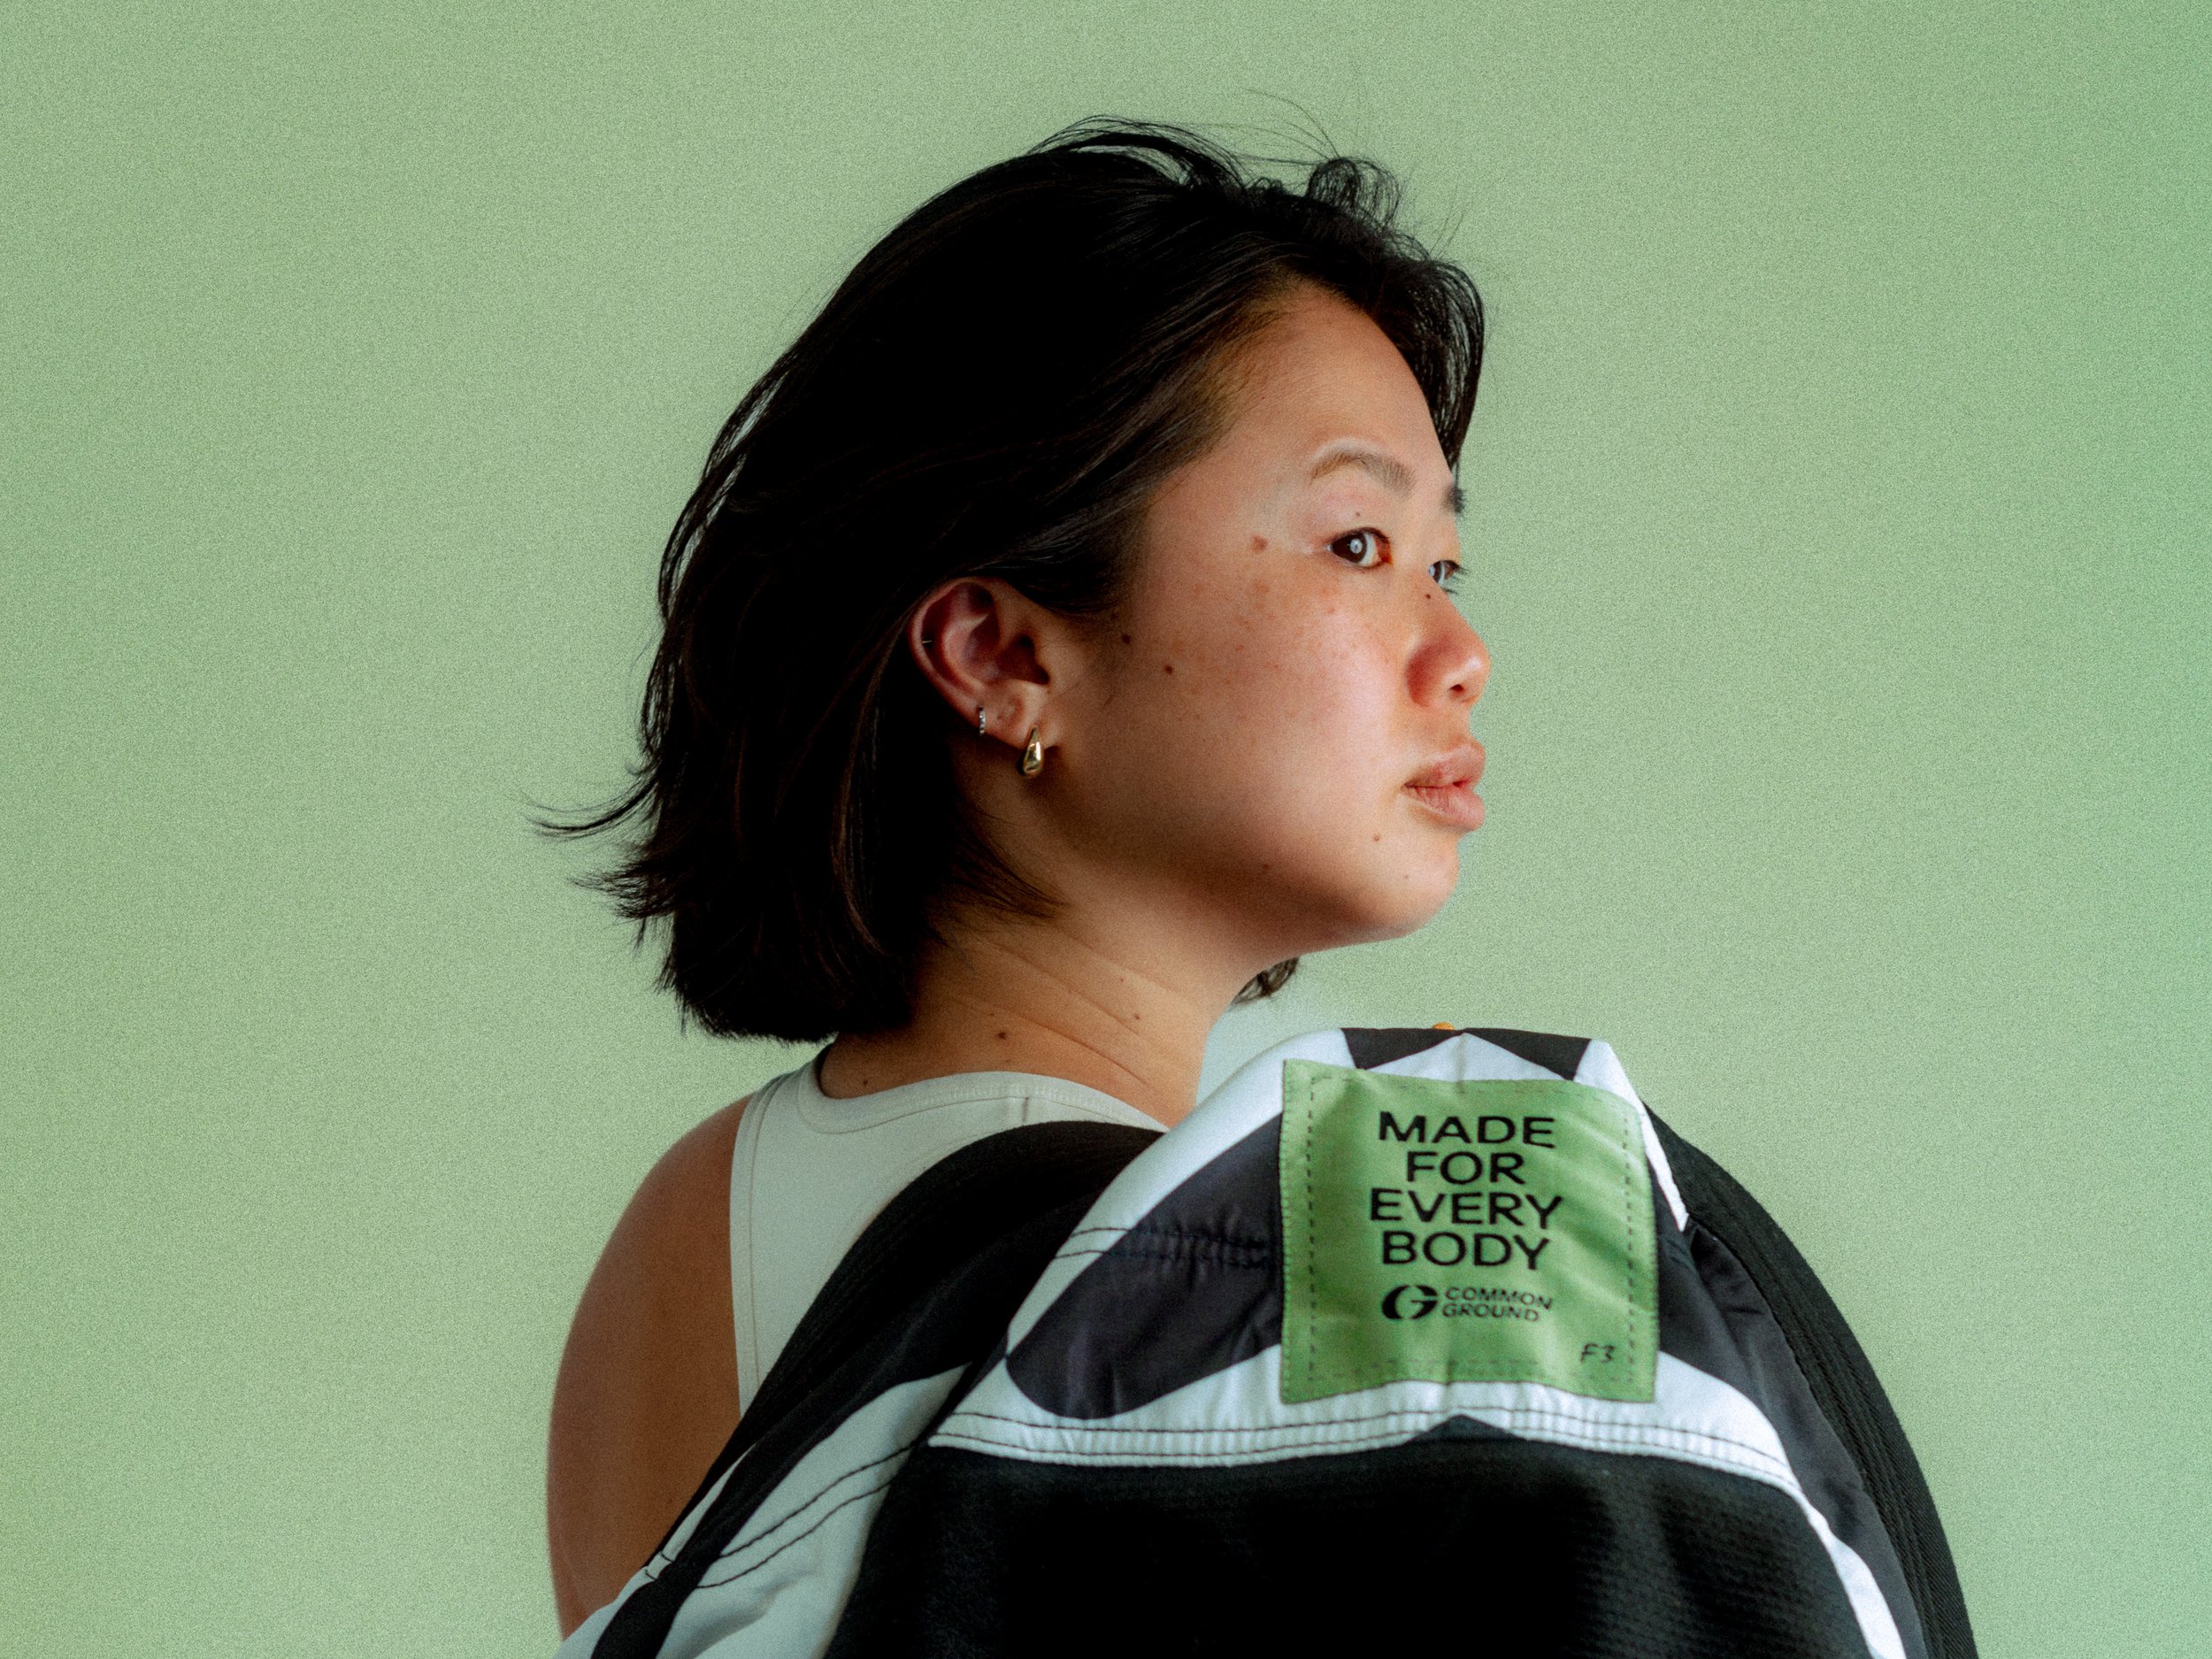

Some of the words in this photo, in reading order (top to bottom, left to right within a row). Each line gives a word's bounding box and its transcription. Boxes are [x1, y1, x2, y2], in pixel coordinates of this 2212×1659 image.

[1379, 1110, 1555, 1148] MADE
[1406, 1150, 1525, 1185] FOR
[1370, 1187, 1563, 1229] EVERY
[1382, 1230, 1549, 1270] BODY
[1442, 1303, 1540, 1322] GROUND
[1444, 1286, 1553, 1310] COMMON
